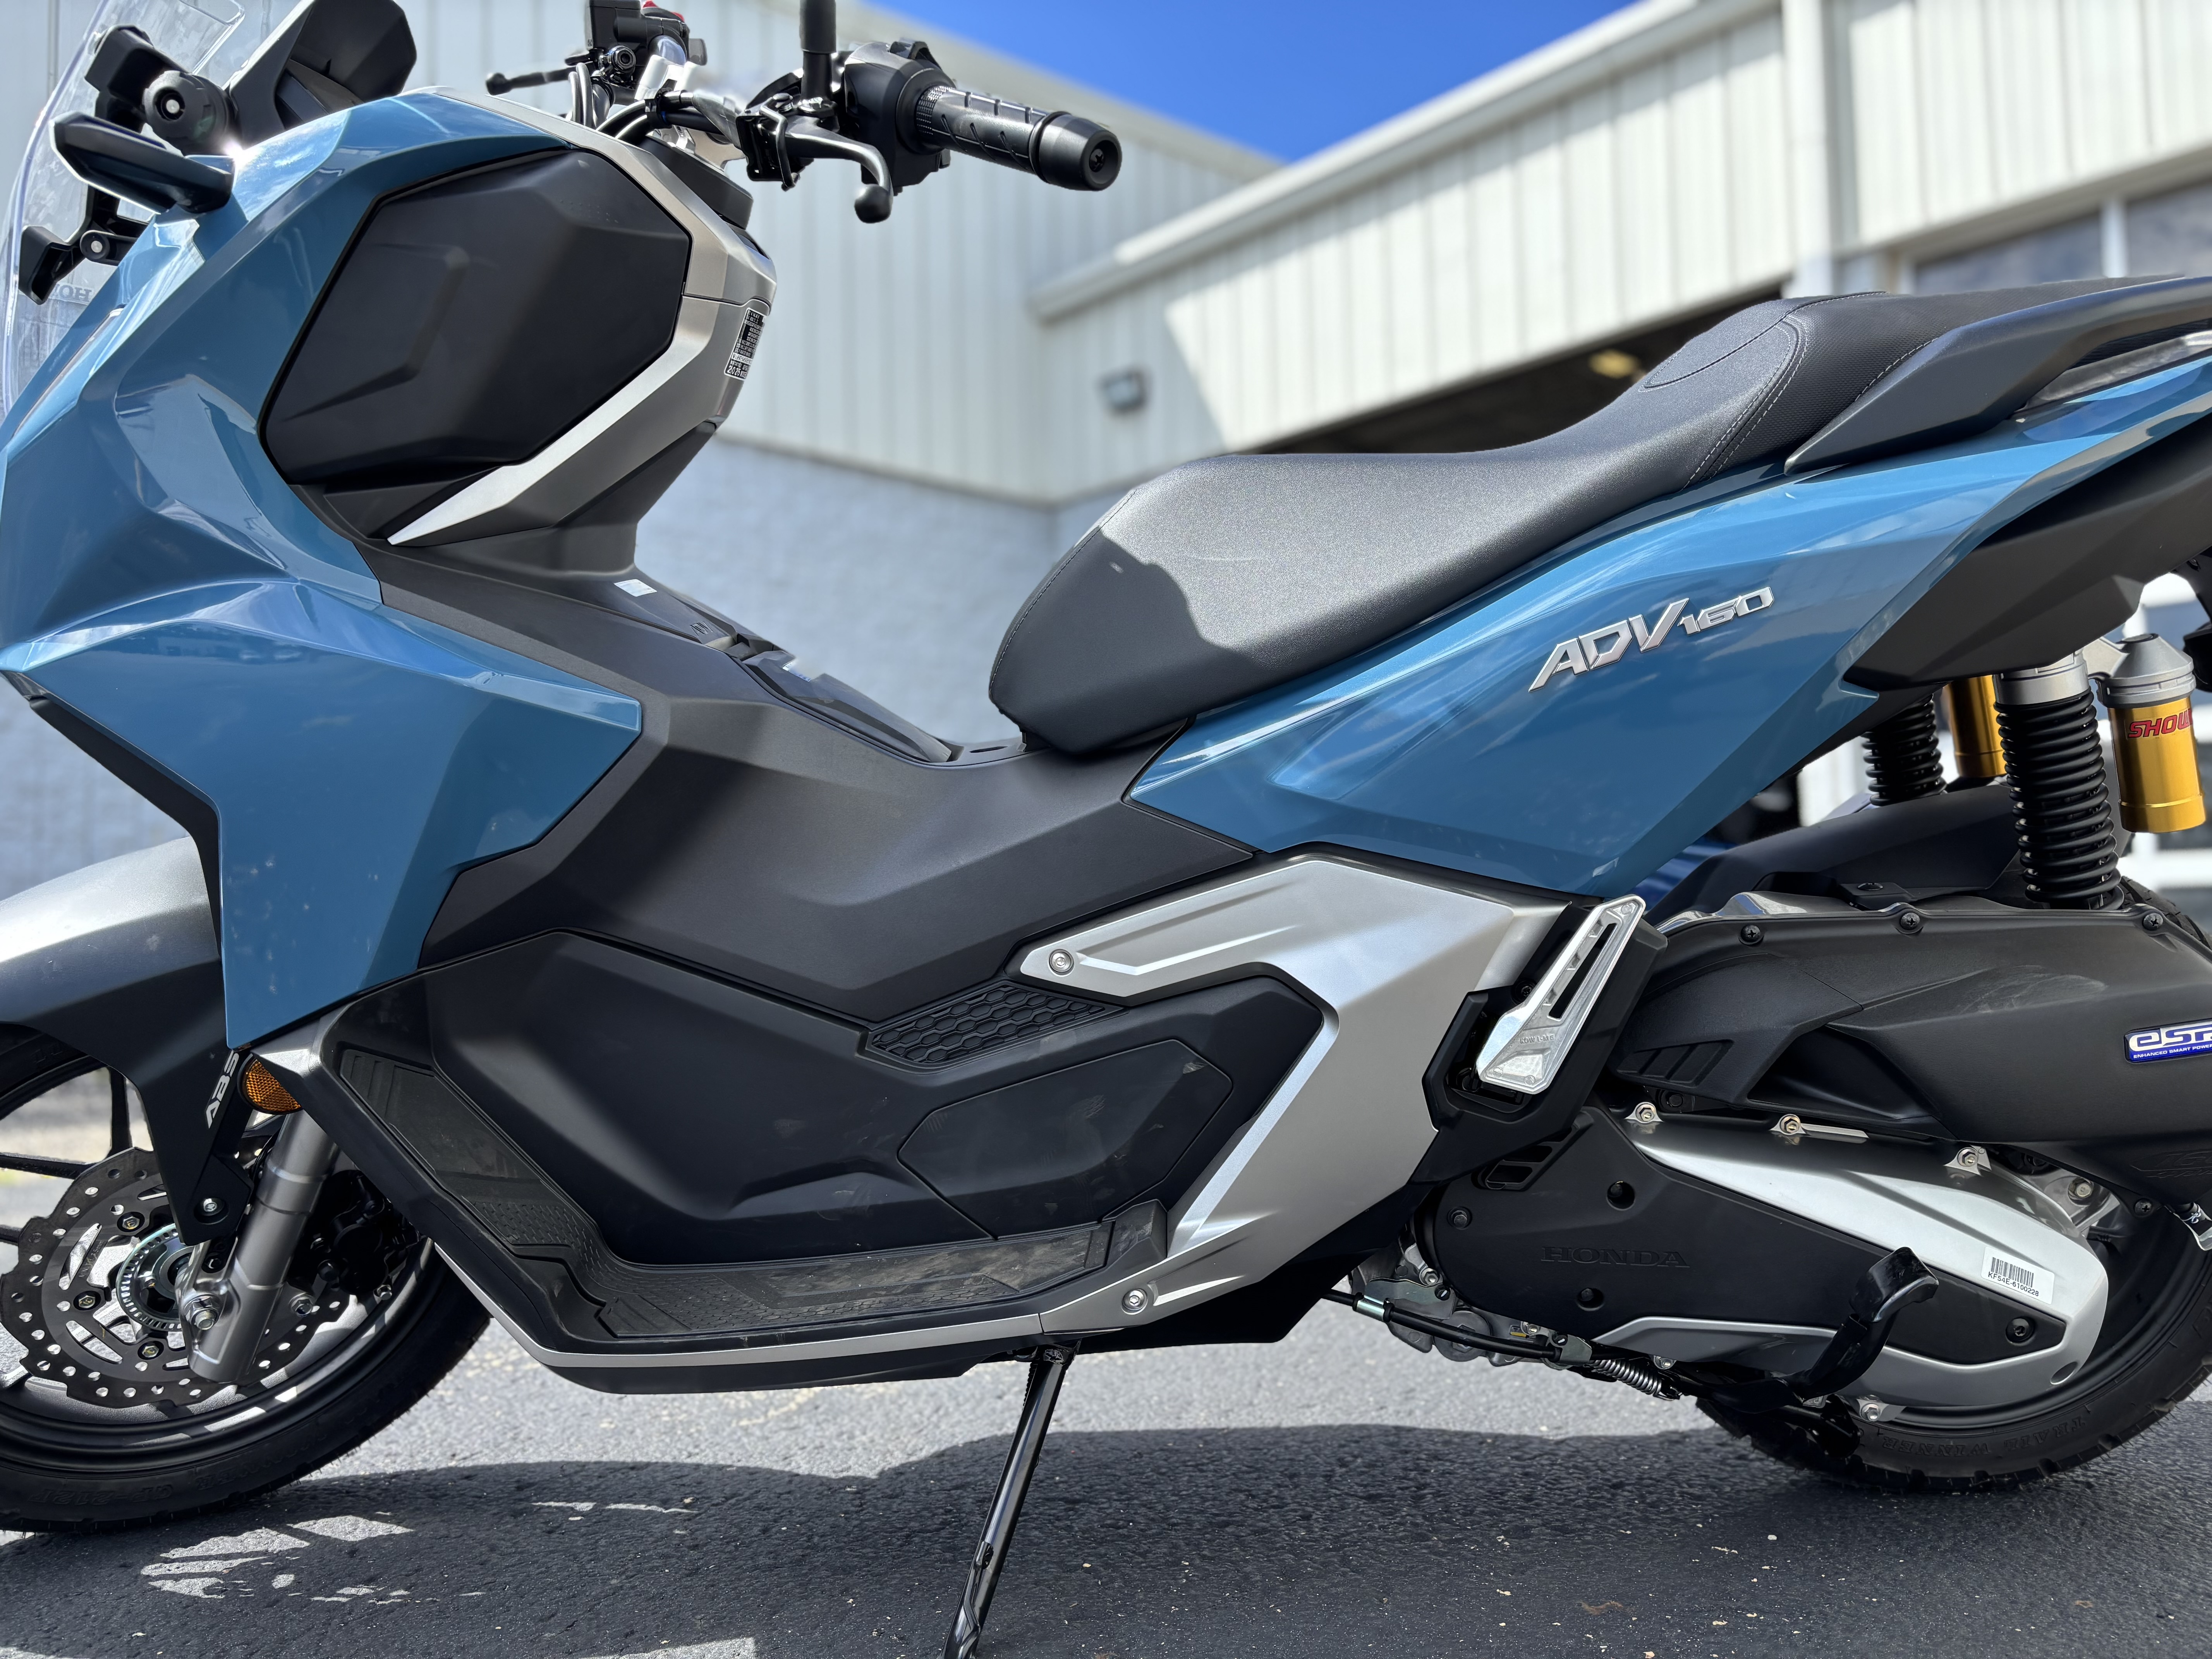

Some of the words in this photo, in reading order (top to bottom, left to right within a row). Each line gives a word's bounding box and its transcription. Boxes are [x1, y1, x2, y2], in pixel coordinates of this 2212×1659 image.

[2133, 1050, 2167, 1059] ENHANCED
[206, 1050, 239, 1129] ABS
[1541, 1246, 1690, 1268] HONDA
[1988, 1271, 2039, 1297] KF54E-6100228
[2004, 1416, 2087, 1449] TRAIL
[1882, 1436, 1992, 1457] WINNER
